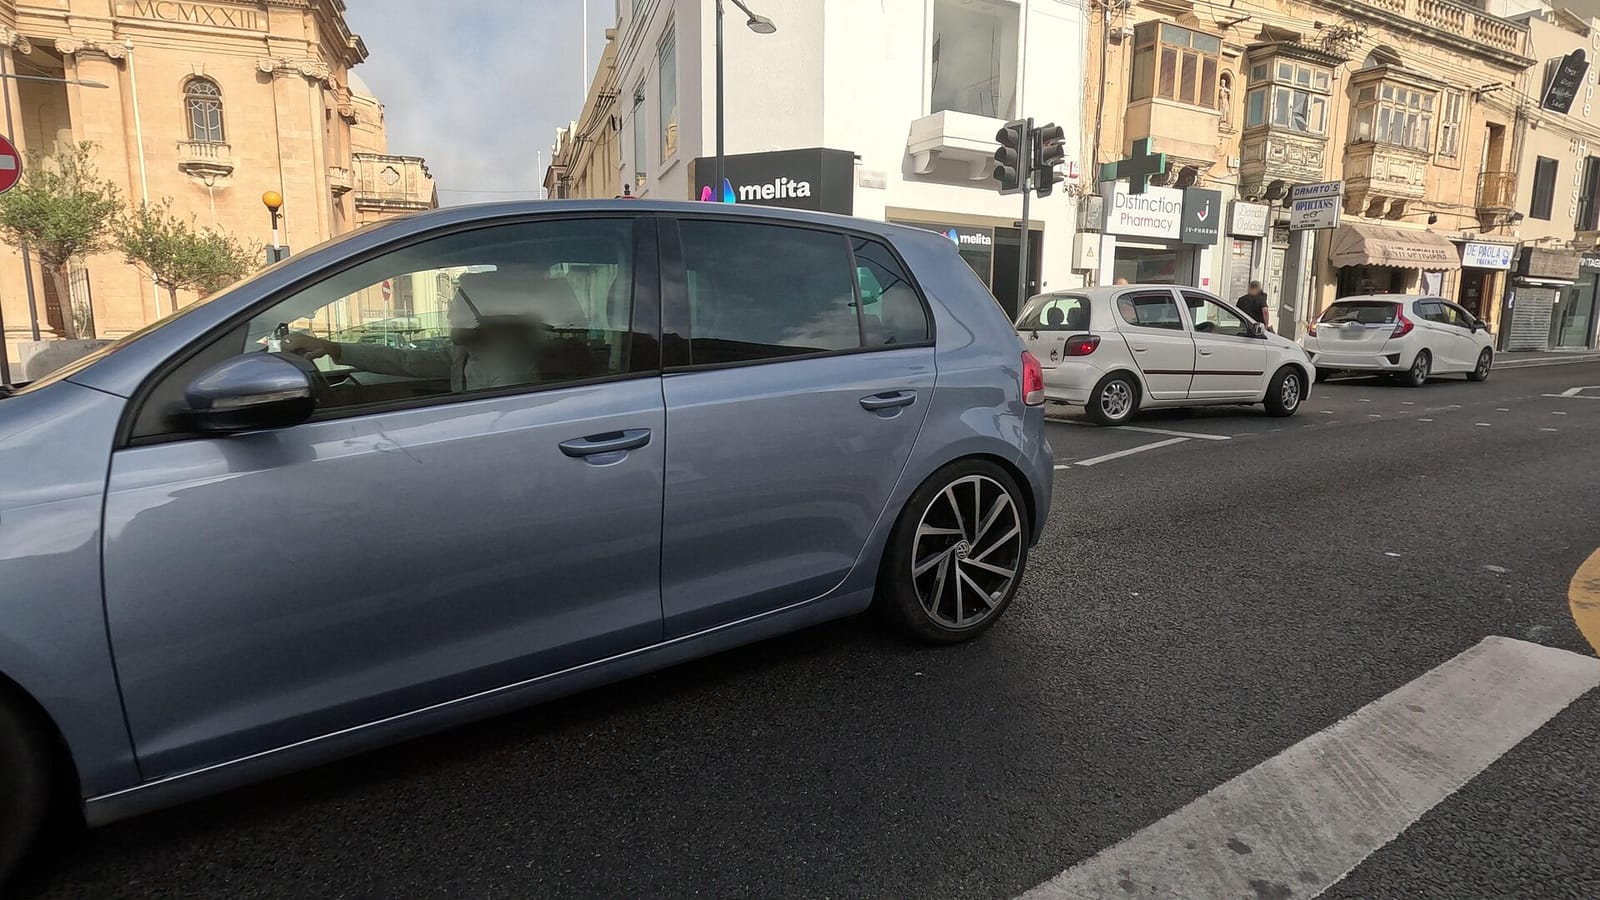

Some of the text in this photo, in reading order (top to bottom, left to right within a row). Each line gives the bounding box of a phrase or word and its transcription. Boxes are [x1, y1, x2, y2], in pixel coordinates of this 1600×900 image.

[132, 0, 258, 29] MCMXXIII
[739, 177, 811, 201] melita
[1294, 183, 1339, 196] DAMATO'S
[1115, 192, 1182, 214] Distinction
[1295, 199, 1334, 211] OPTICIANS
[1120, 213, 1173, 232] Pharmacy
[959, 233, 992, 245] melita
[1466, 244, 1501, 258] DE PAOLA
